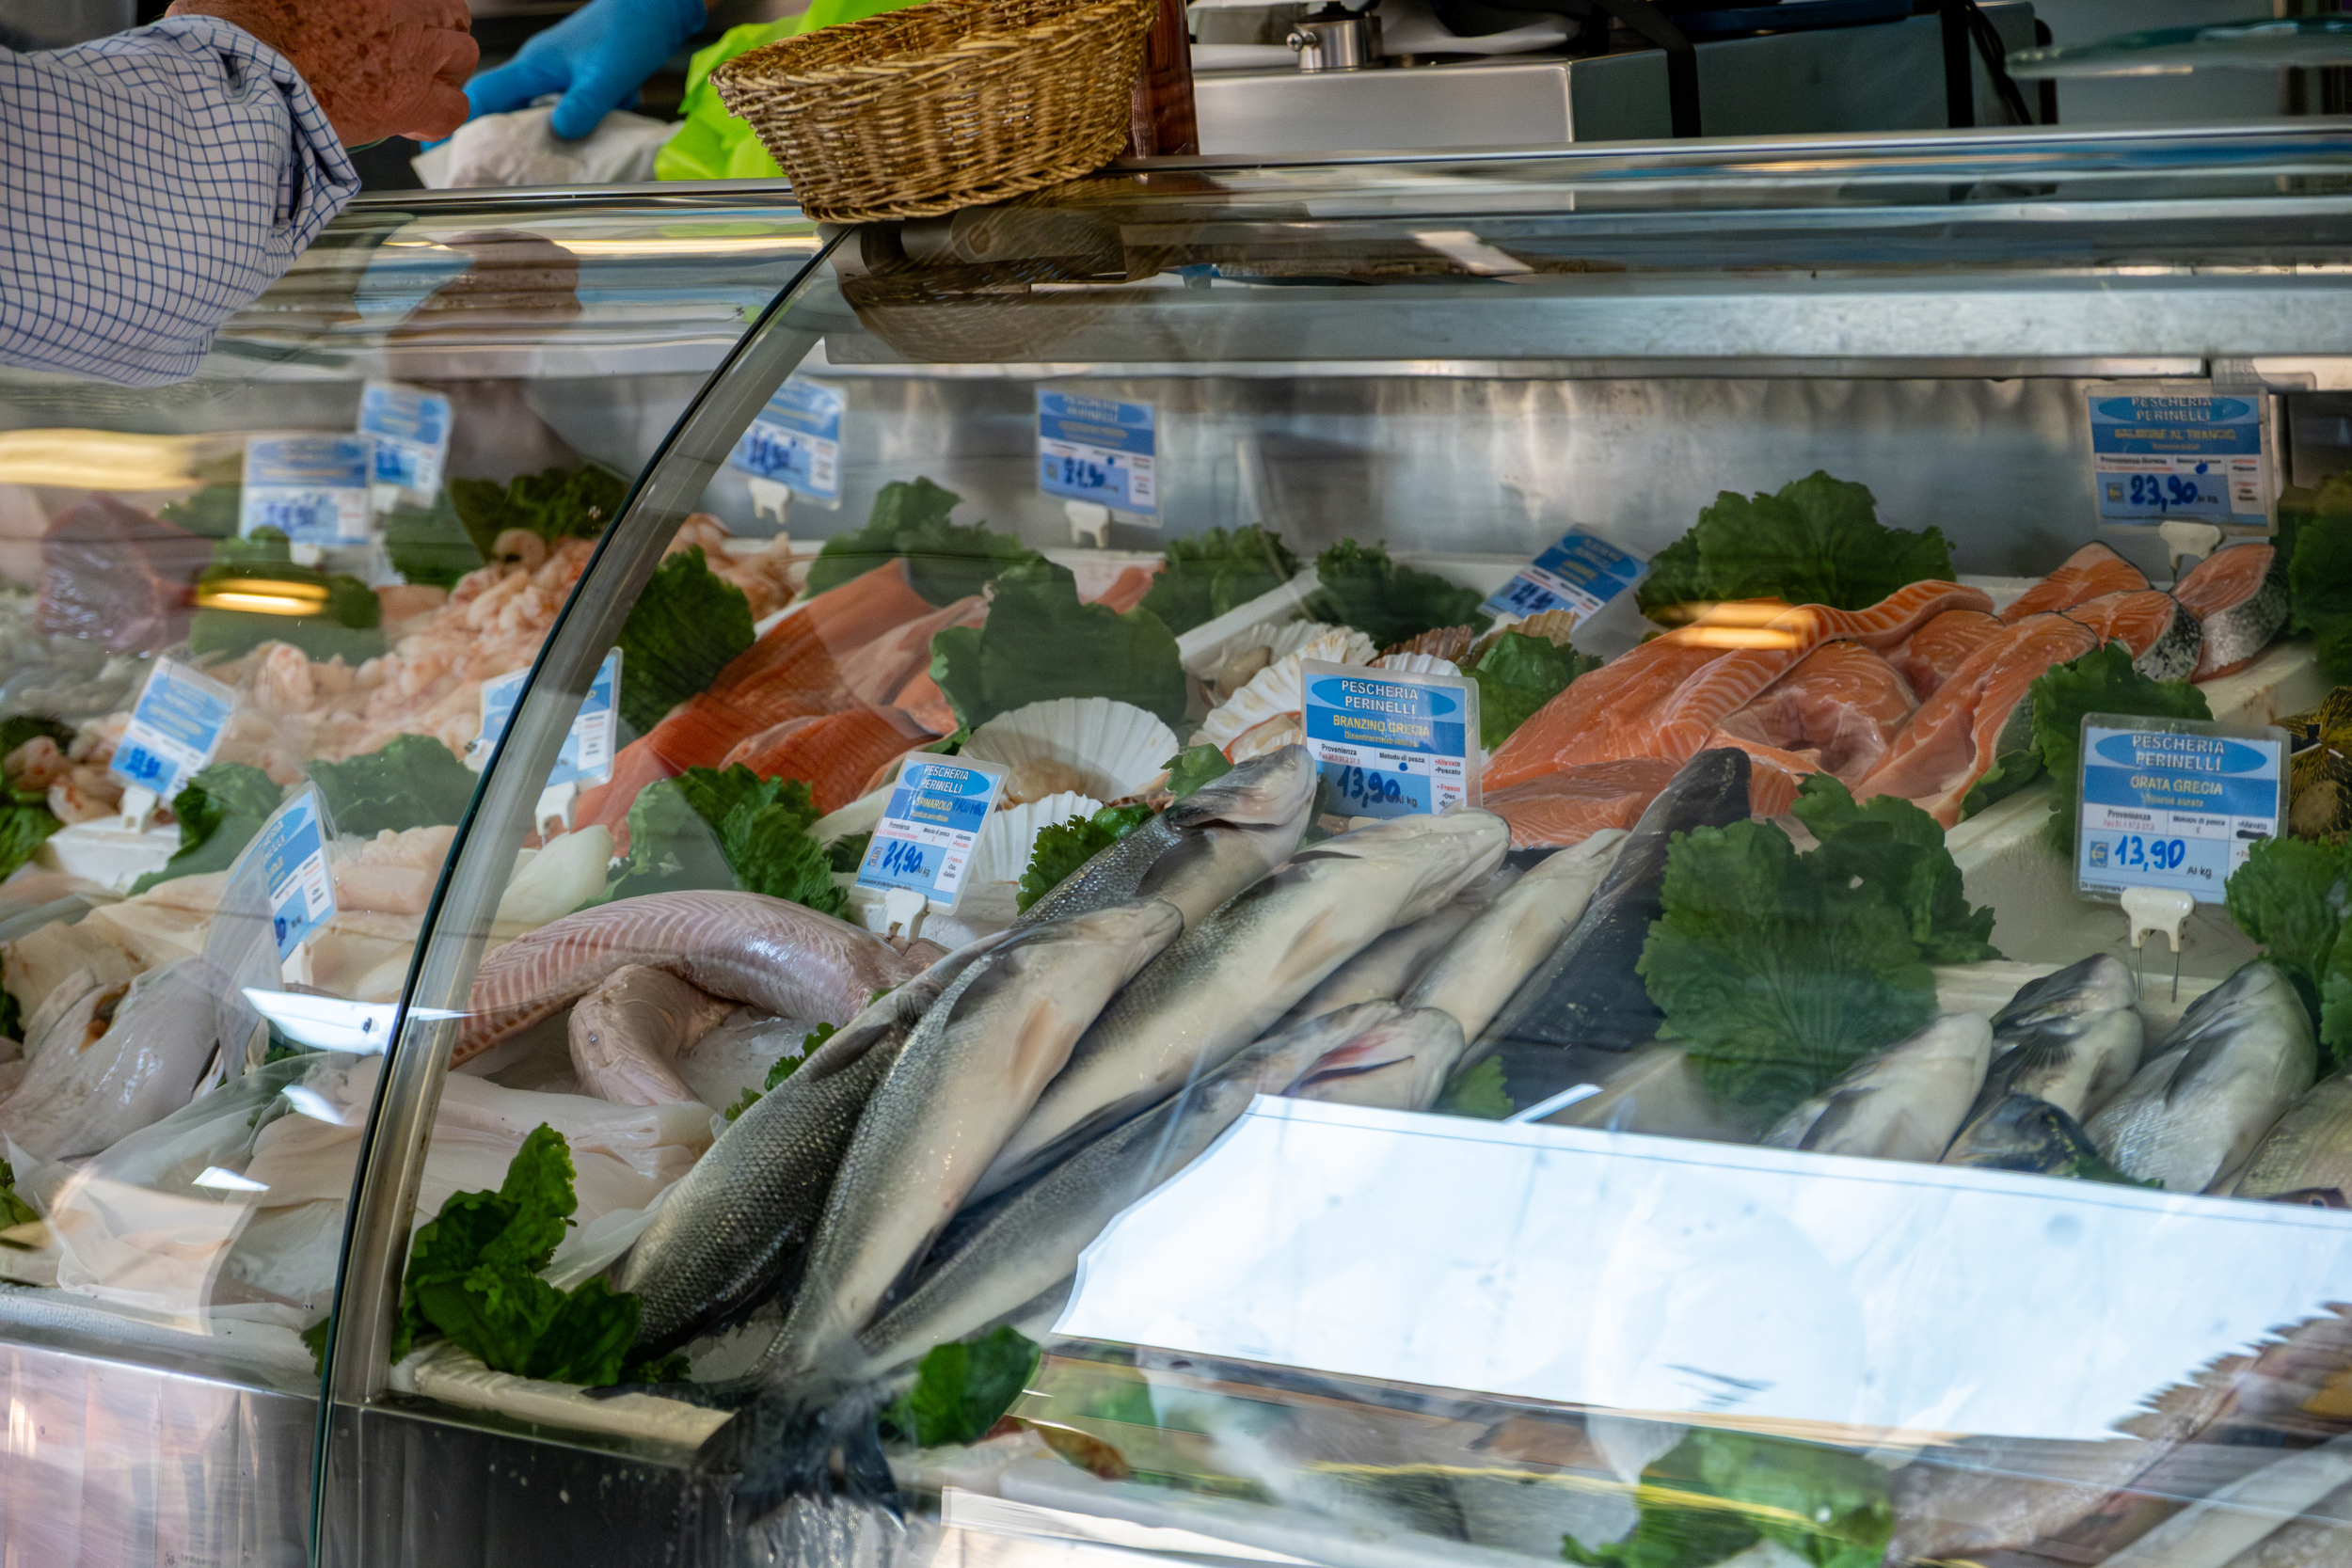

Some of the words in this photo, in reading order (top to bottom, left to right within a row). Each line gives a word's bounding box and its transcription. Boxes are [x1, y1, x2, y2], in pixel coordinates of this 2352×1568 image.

[2131, 396, 2212, 407] PESCHERIA
[2136, 409, 2211, 422] PERINELLI
[2130, 474, 2198, 513] 23,90
[1342, 679, 1419, 701] PESCHERIA
[1344, 695, 1416, 715] PERINELLI
[1333, 715, 1386, 732] BRANZINO
[1388, 722, 1430, 737] GRECIA
[1322, 743, 1358, 756] Provenienza
[2132, 734, 2225, 754] PESCHERIA
[1379, 752, 1400, 761] Metodo
[2136, 752, 2221, 771] PERINELLI
[923, 765, 970, 782] PESCHERIA
[920, 779, 963, 795] PERINELLI
[1337, 765, 1401, 809] 13,90
[2130, 775, 2171, 792] ORATA
[2173, 779, 2223, 795] GRECIA
[915, 797, 953, 812] SPINAROLO
[1406, 796, 1418, 808] kg
[882, 840, 923, 878] 21,90
[2114, 834, 2185, 872] 13,90
[2201, 865, 2212, 879] kg
